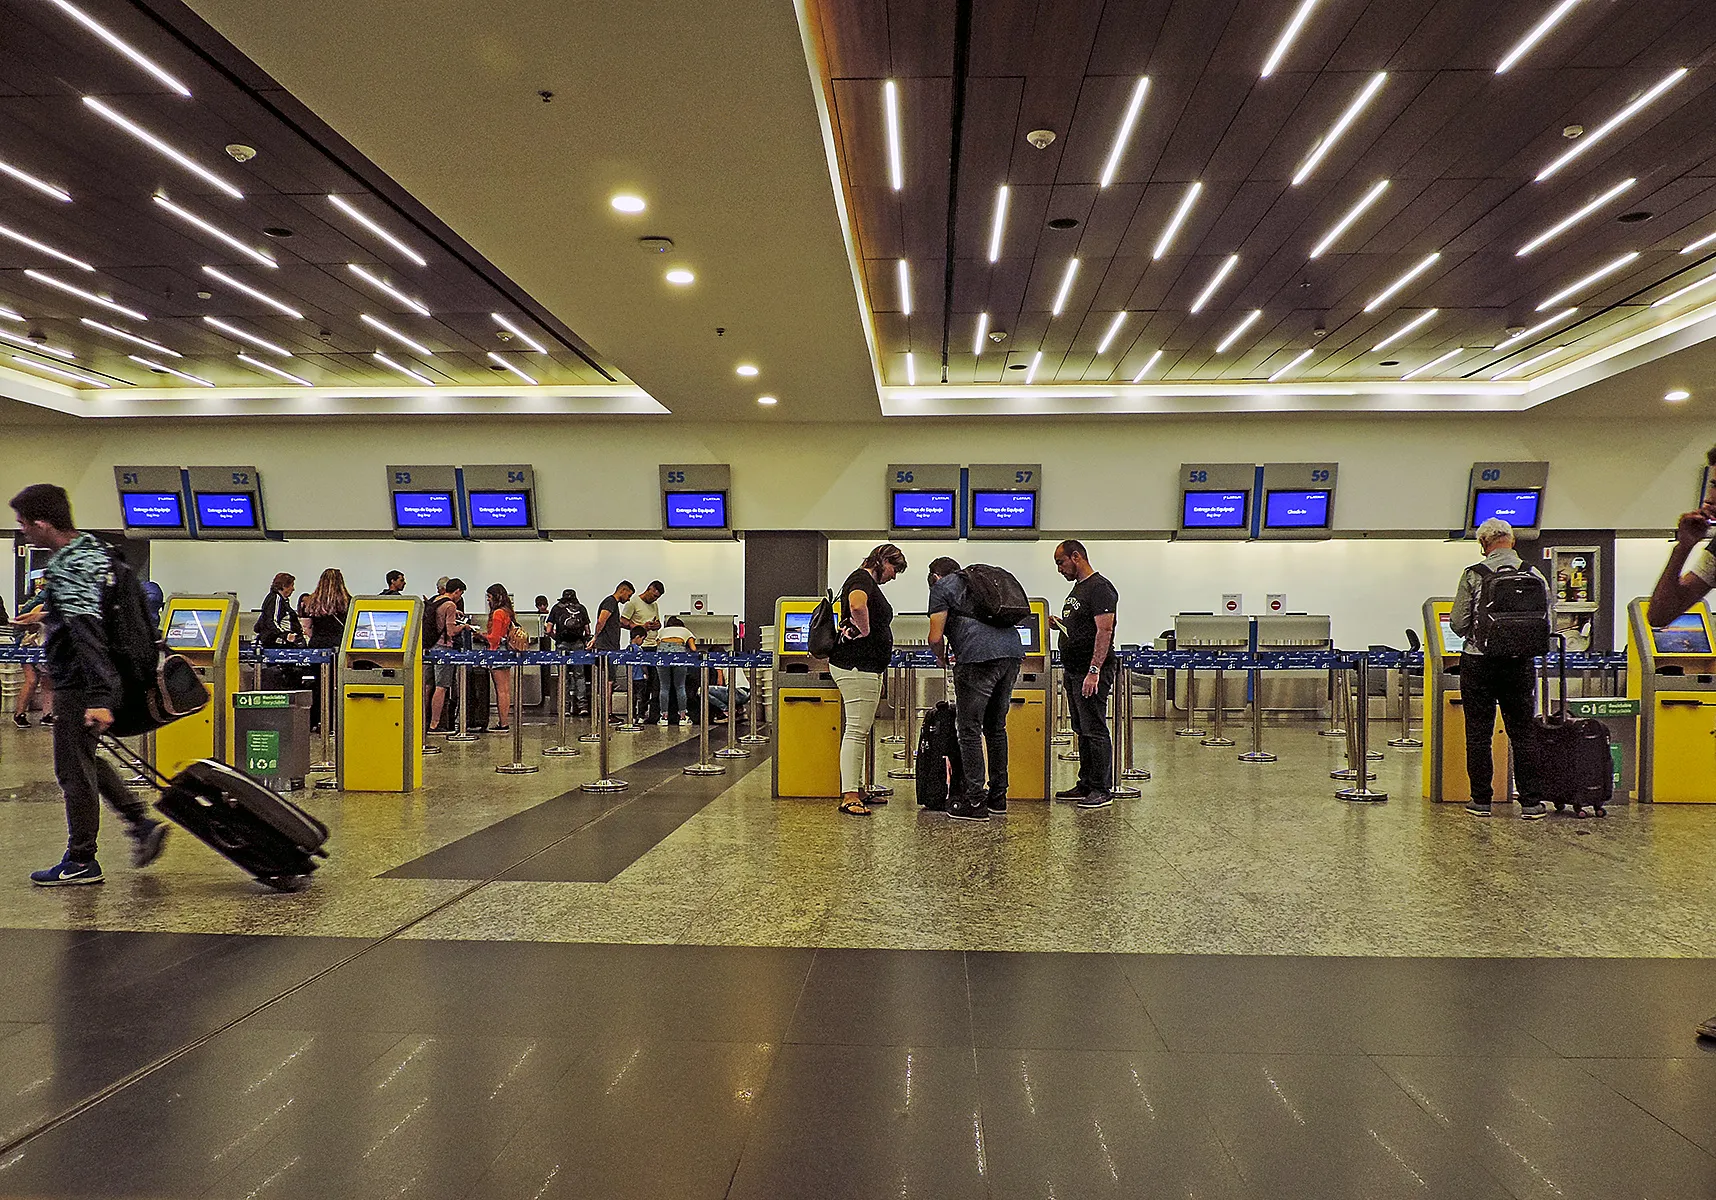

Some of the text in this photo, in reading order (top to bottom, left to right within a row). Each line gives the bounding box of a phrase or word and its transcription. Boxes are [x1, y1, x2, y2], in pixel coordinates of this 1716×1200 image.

[123, 473, 138, 484] 51
[232, 473, 249, 484] 52
[395, 472, 411, 484] 53
[507, 472, 525, 483] 54
[667, 471, 685, 483] 55
[896, 471, 914, 483] 56
[1015, 471, 1033, 483] 57
[1189, 470, 1207, 483] 58
[1311, 469, 1330, 482] 59
[1481, 469, 1500, 481] 60
